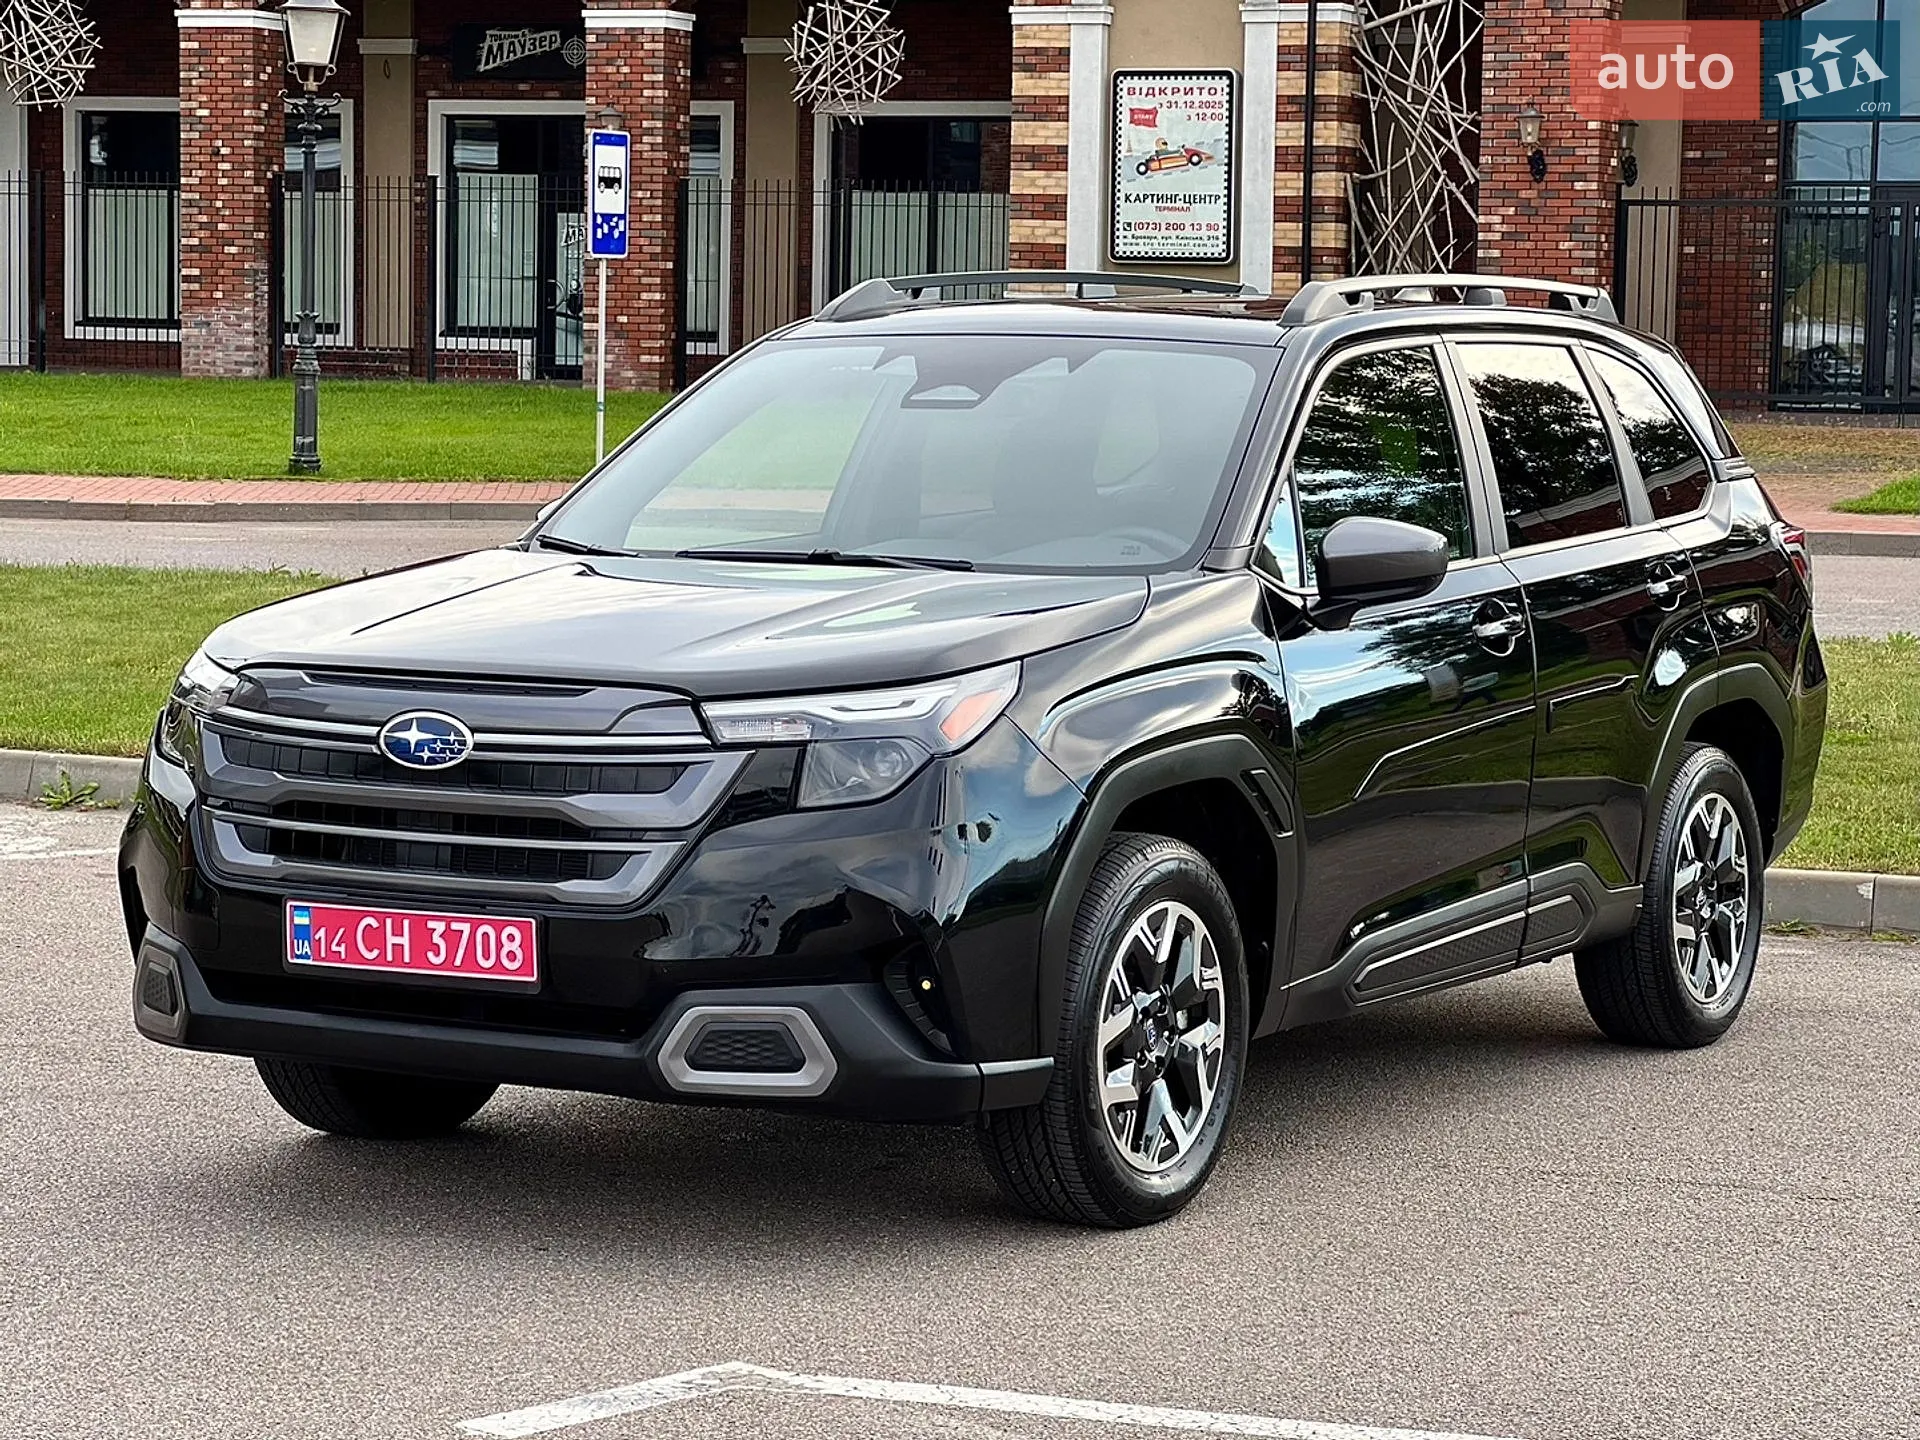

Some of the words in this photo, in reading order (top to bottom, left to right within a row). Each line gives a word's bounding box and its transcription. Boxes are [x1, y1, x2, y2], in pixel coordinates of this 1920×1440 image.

[1126, 86, 1224, 98] ВІДКРИТО!
[1166, 100, 1224, 109] 31.12.2025
[1124, 193, 1221, 206] КАРТИНГ-ЦЕНТР
[1154, 205, 1191, 213] ТЕРМІНАЛ
[1133, 221, 1162, 232] (073)
[1165, 222, 1186, 231] 200
[1189, 222, 1203, 231] 13
[1206, 222, 1220, 232] 90
[293, 939, 312, 956] UA
[314, 926, 347, 960] 14
[425, 919, 525, 971] 3708
